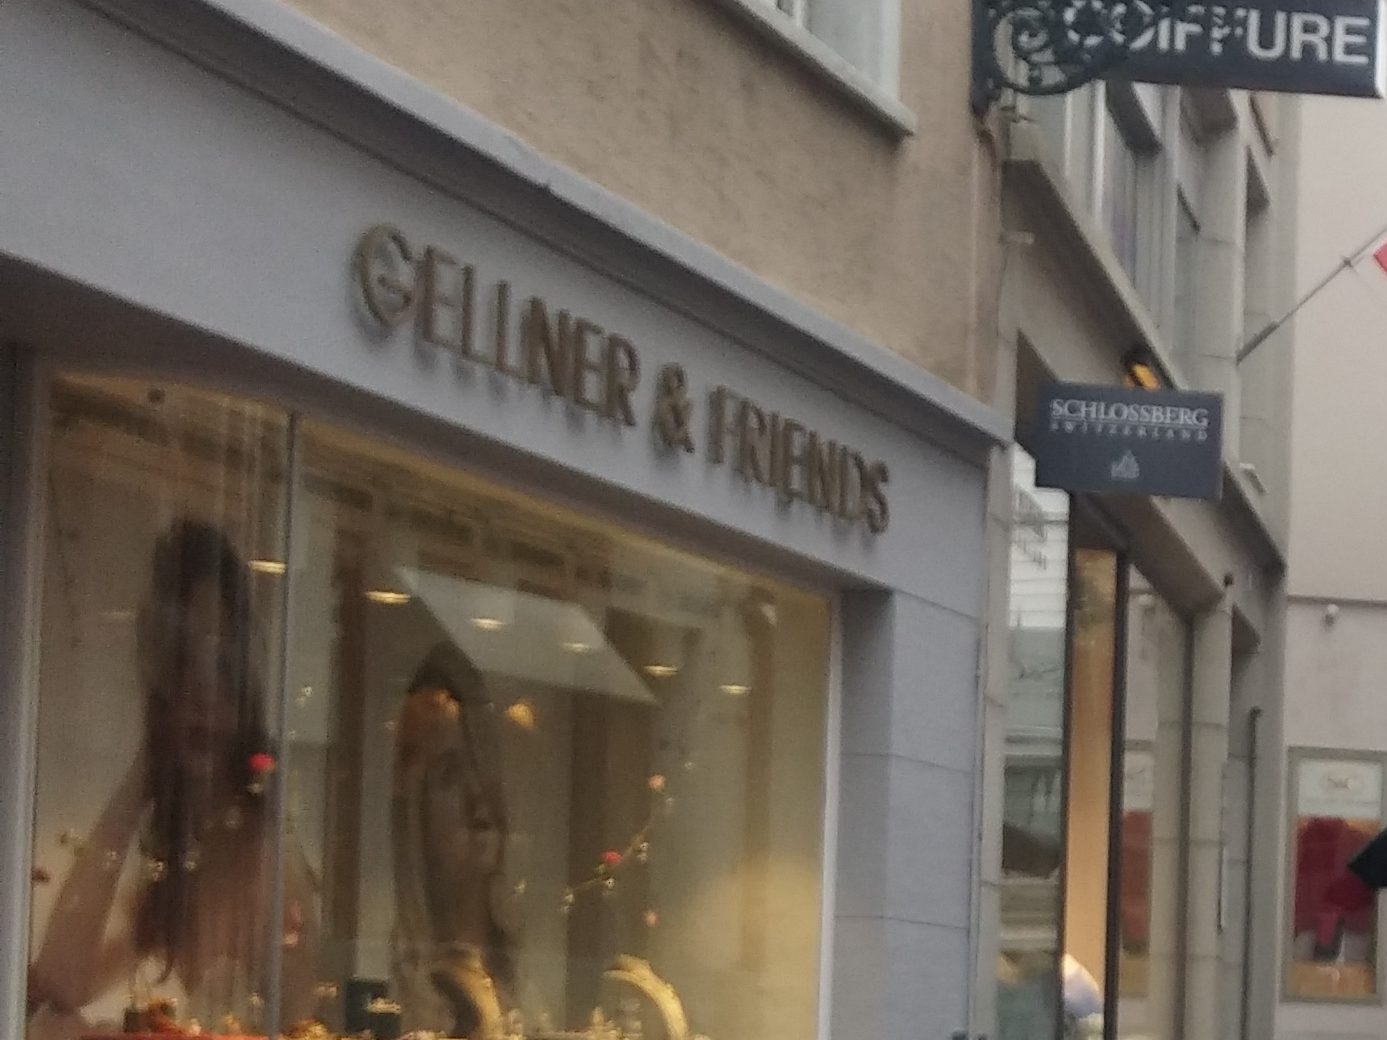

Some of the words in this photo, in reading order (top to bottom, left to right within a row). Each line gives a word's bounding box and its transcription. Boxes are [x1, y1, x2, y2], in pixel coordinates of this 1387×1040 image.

[354, 222, 641, 427] GELLNER
[655, 362, 696, 454] &
[708, 384, 890, 535] FRIENDS
[1051, 398, 1209, 428] SCHLOSSBERG
[1050, 420, 1209, 442] SWITZERLAND
